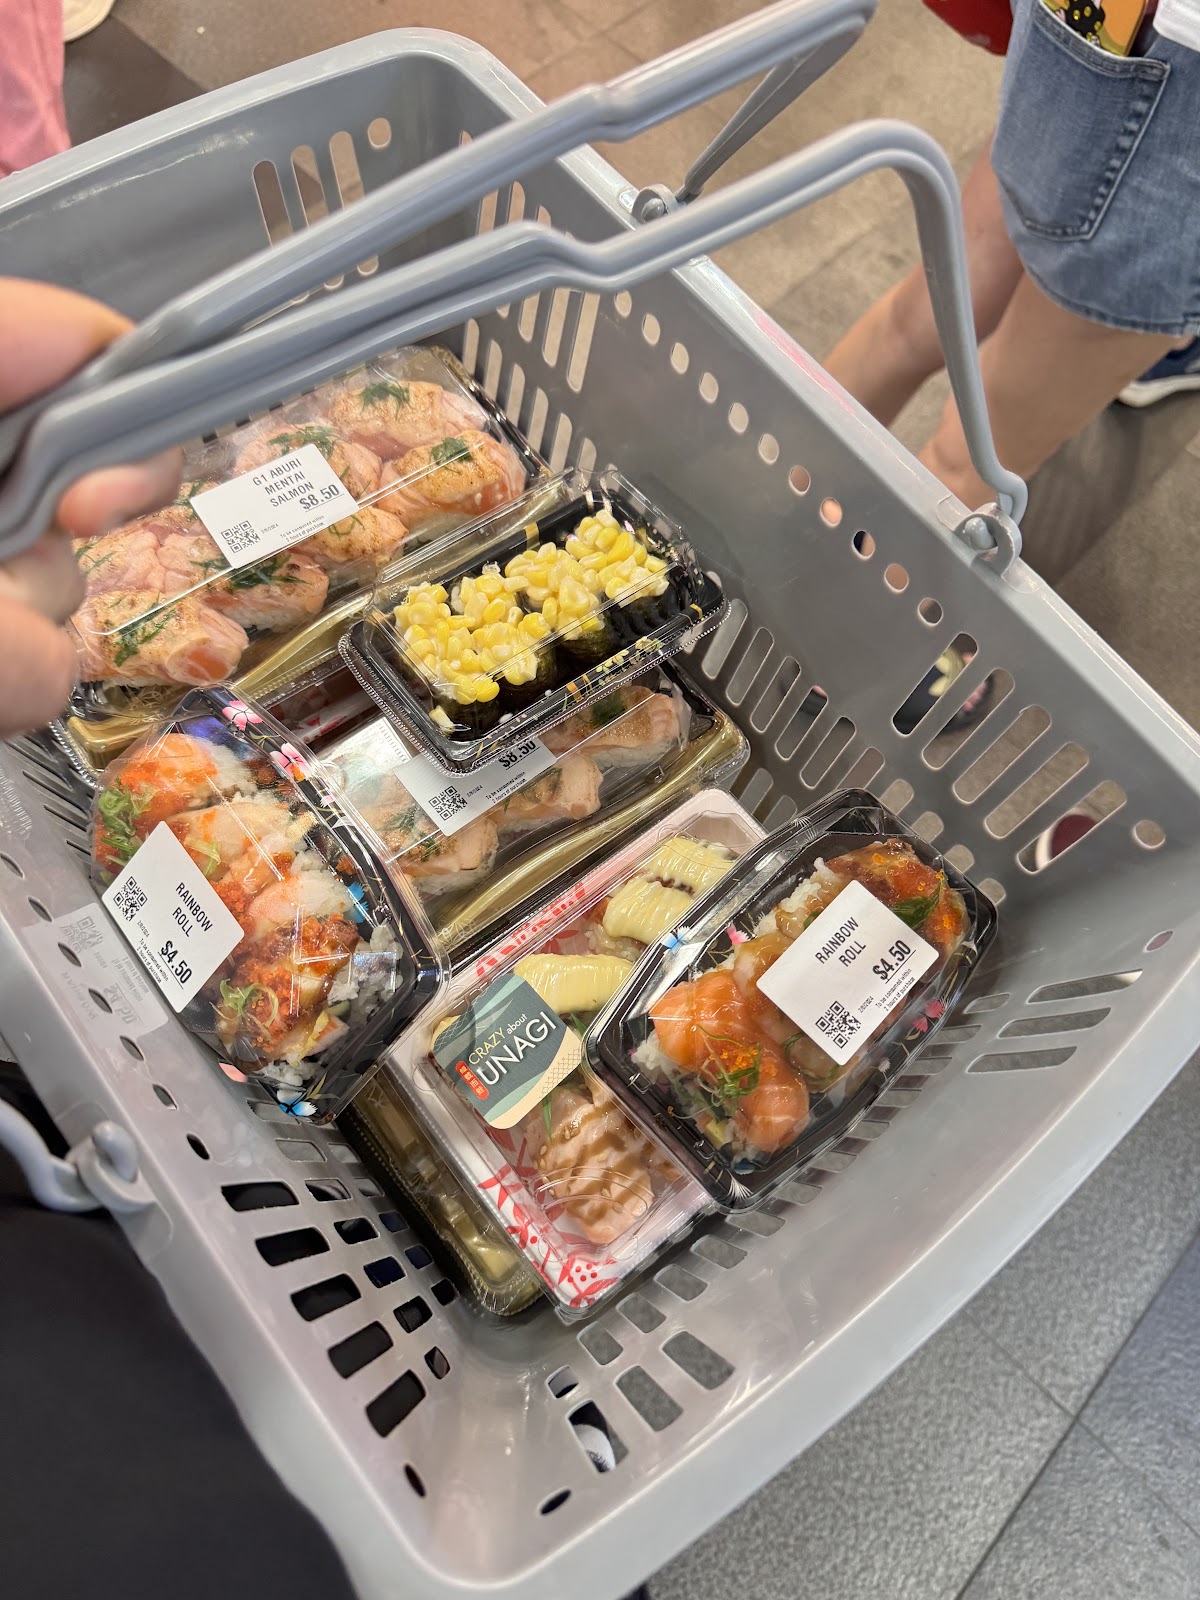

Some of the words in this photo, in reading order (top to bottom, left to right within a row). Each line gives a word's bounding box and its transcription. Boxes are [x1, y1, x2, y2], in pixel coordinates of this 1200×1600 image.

[252, 474, 267, 486] G1
[270, 458, 302, 479] ABURI
[264, 471, 306, 495] MENTAI
[270, 481, 314, 507] SALMON
[299, 484, 340, 511] $8.50
[499, 740, 537, 768] $8.50
[172, 907, 192, 937] ROLL
[175, 882, 213, 932] RAINBOW
[815, 916, 859, 965] RAINBOW
[838, 940, 867, 967] ROLL
[160, 940, 193, 984] $4.50
[872, 939, 911, 982] $4.50
[468, 1027, 506, 1065] CRAZY
[506, 1013, 528, 1035] about
[476, 1011, 557, 1085] UNAGI
